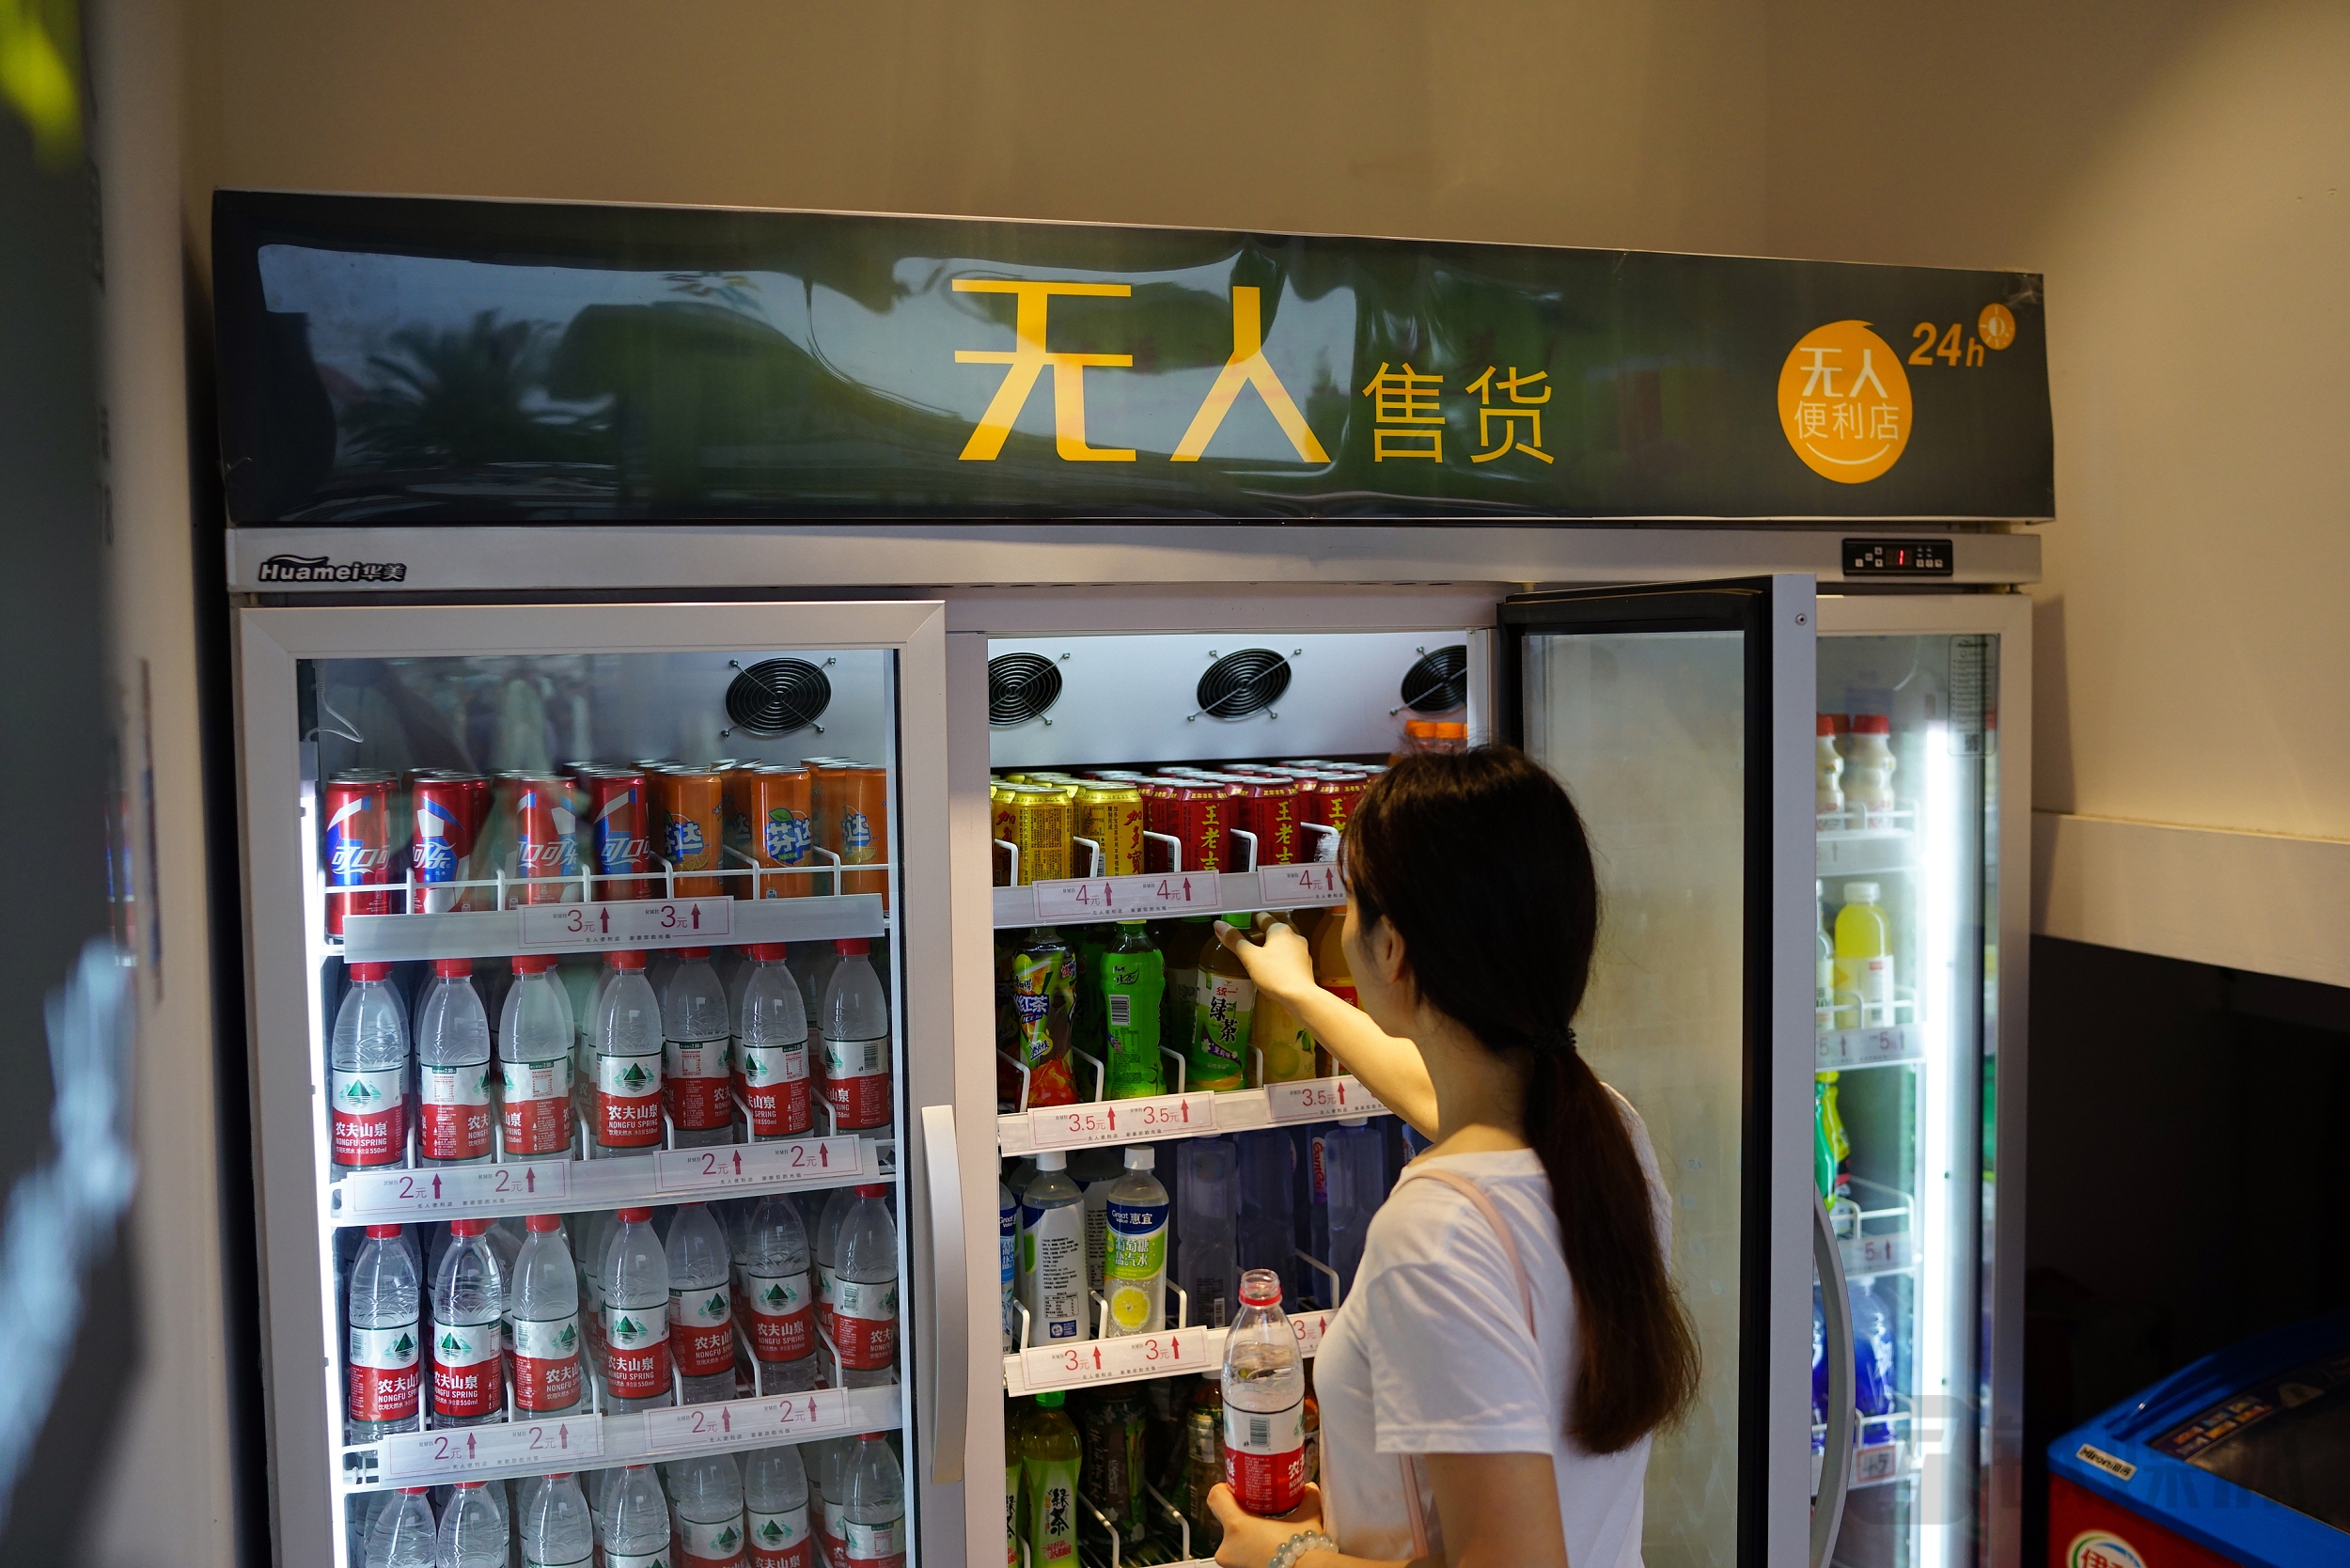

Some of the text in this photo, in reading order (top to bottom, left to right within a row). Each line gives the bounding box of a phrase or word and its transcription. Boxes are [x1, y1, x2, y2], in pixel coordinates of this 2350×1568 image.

[1908, 321, 1984, 368] 24h
[1799, 347, 1888, 399] 无人
[1794, 400, 1899, 440] 便利店
[768, 821, 810, 856] 芬达
[1299, 870, 1323, 890] 4元
[1075, 885, 1101, 906] 4元
[1157, 880, 1182, 901] 4元
[568, 910, 595, 933] 3元
[661, 905, 687, 928] 3元
[1216, 987, 1237, 997] 统一
[1210, 996, 1238, 1043] 绿茶
[1302, 1089, 1337, 1106] 3.5元
[608, 1104, 658, 1120] 农夫山泉
[1069, 1113, 1105, 1132] 3.5元
[1143, 1105, 1180, 1124] 3.5元
[336, 1121, 387, 1138] 农夫山泉
[637, 1119, 658, 1128] SPRING
[337, 1137, 387, 1147] NONGFU SPRING
[701, 1153, 728, 1175] 2元
[791, 1145, 817, 1168] 2元
[399, 1176, 427, 1199] 2元
[494, 1169, 523, 1193] 2元
[1130, 1213, 1152, 1225] 惠宜
[1115, 1237, 1150, 1253] 葡萄糖
[1115, 1251, 1148, 1267] 盐汽水
[758, 1321, 805, 1337] 农夫山泉
[1293, 1320, 1316, 1340] 3元
[759, 1334, 805, 1345] NONGFU SPRING
[696, 1349, 721, 1359] NONGFU
[1064, 1350, 1089, 1371] 3元
[1145, 1340, 1169, 1360] 3元
[608, 1357, 654, 1372] 农夫山泉
[630, 1372, 654, 1381] SPRING
[451, 1390, 478, 1399] SPRING
[547, 1383, 572, 1392] NONGFU
[379, 1393, 406, 1403] NONGFU
[691, 1411, 718, 1434] 2元
[779, 1400, 806, 1422] 2元
[434, 1436, 462, 1460] 2元
[529, 1427, 556, 1450] 2元
